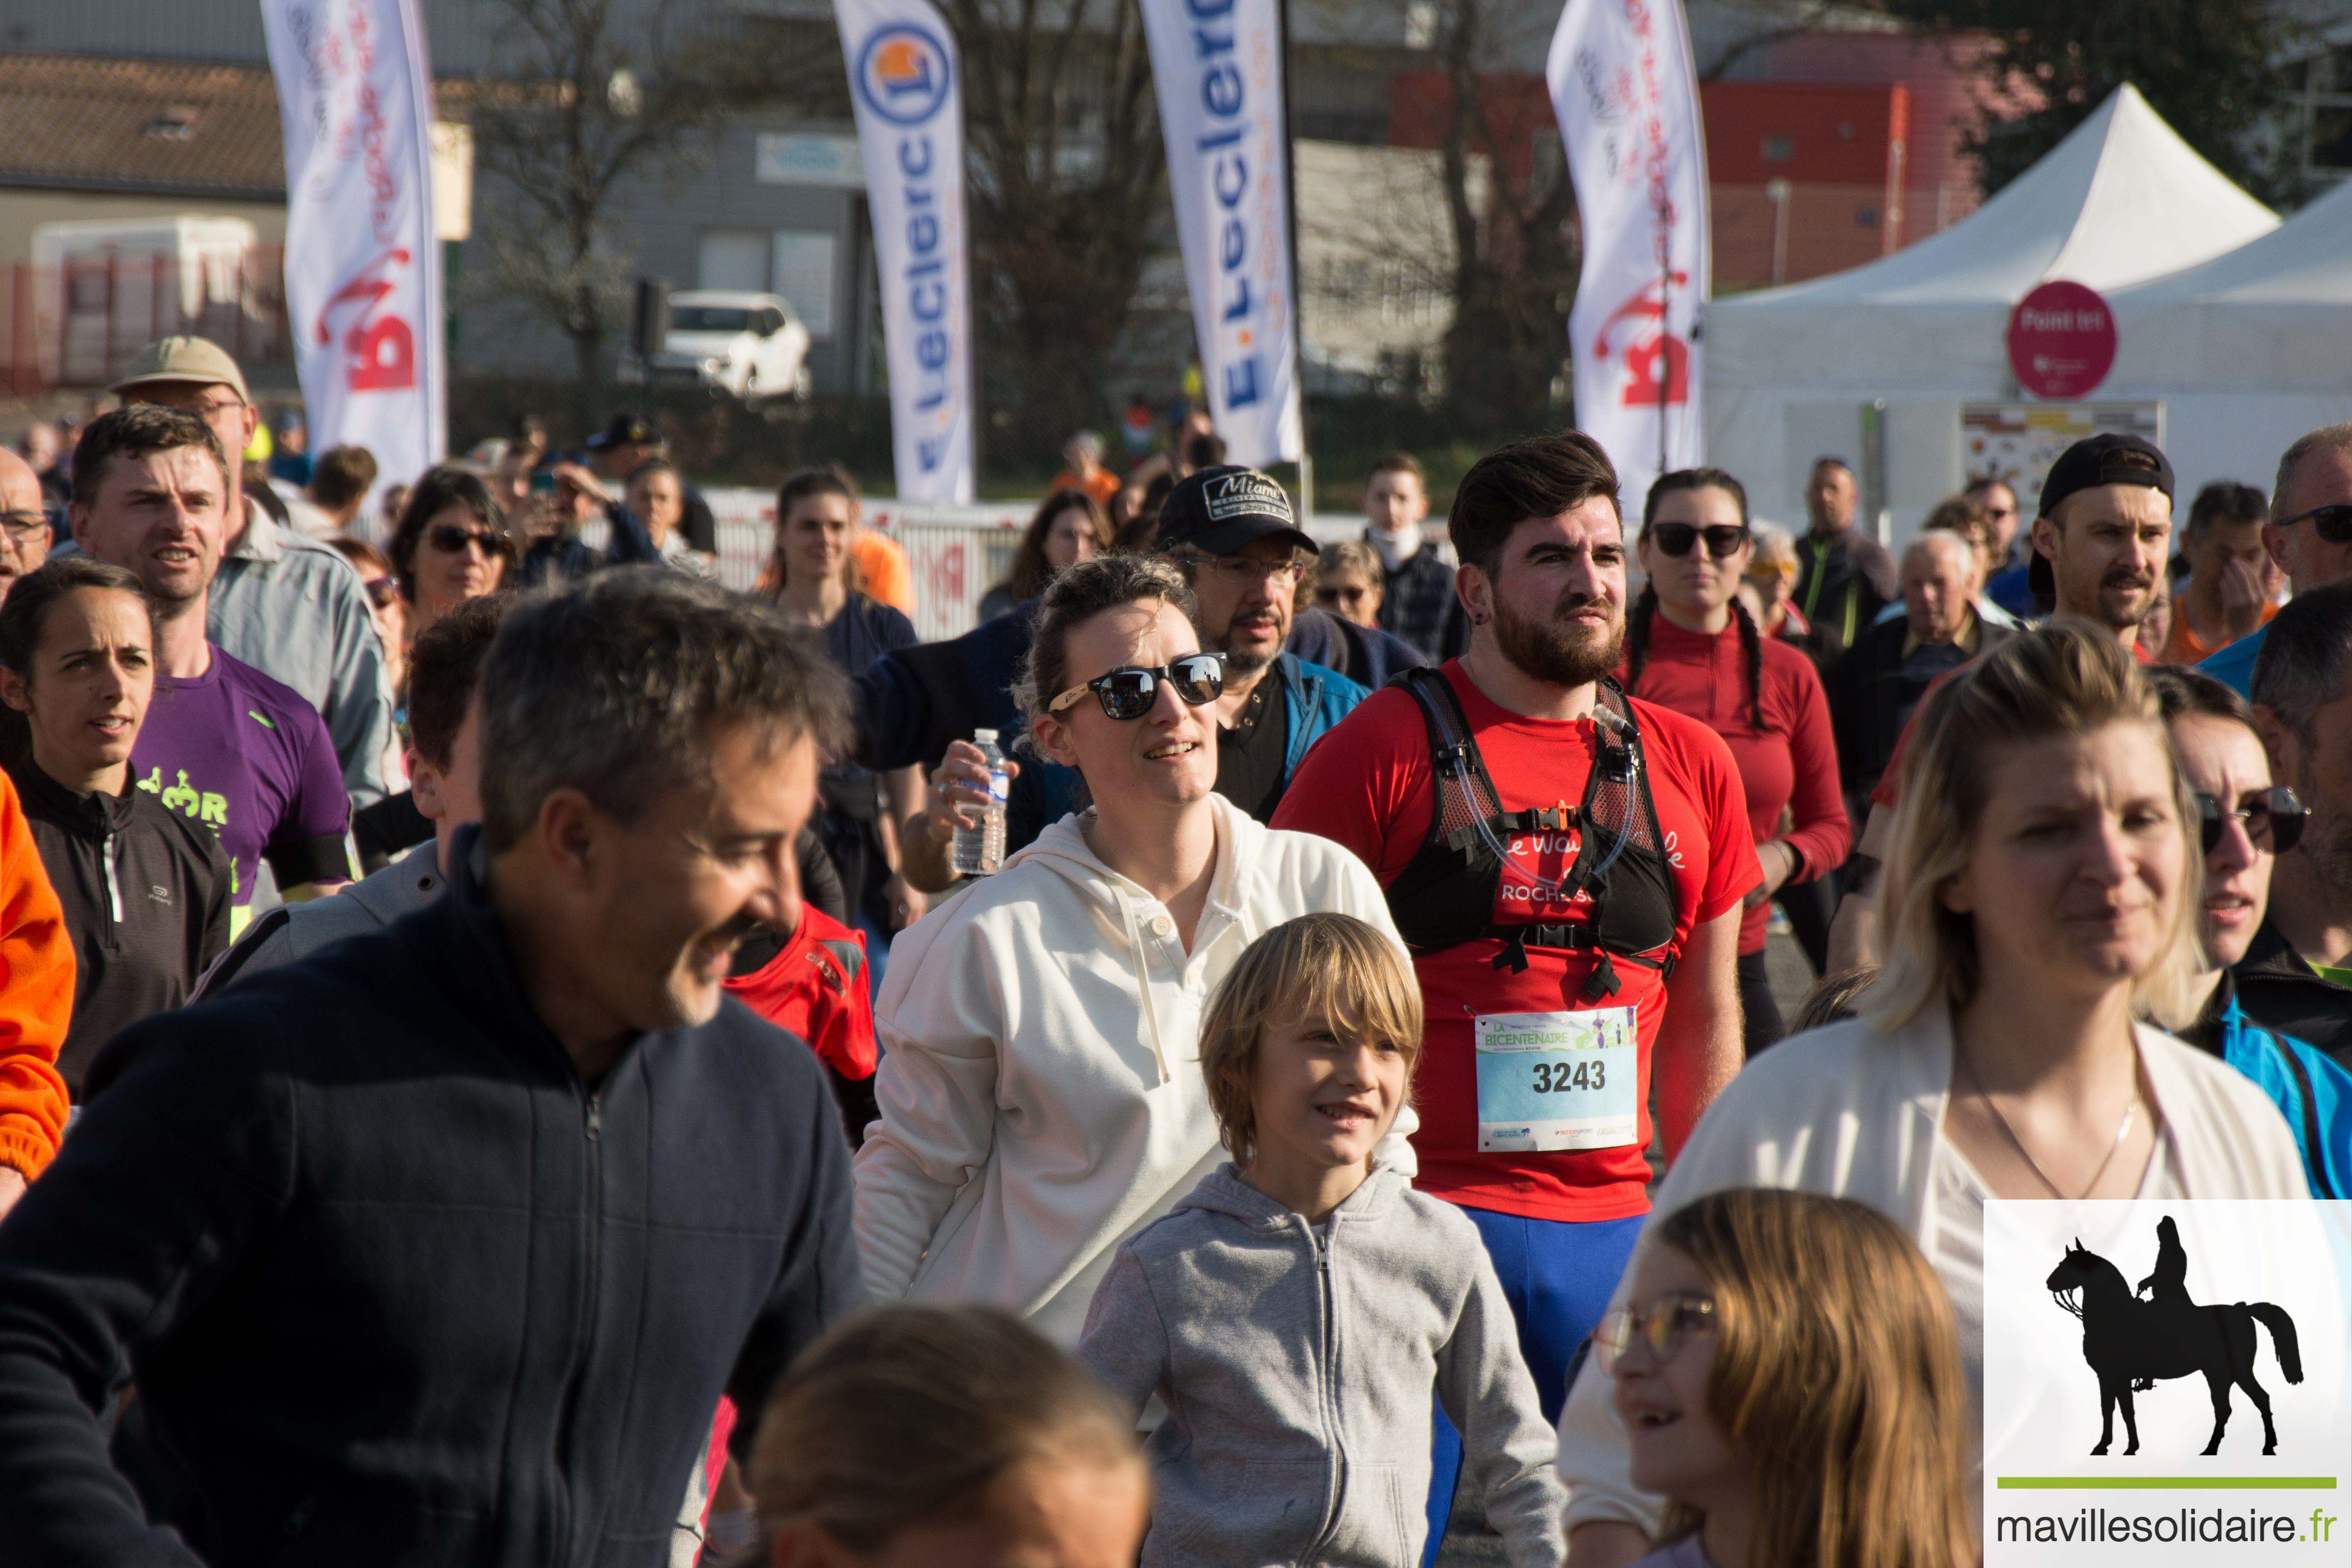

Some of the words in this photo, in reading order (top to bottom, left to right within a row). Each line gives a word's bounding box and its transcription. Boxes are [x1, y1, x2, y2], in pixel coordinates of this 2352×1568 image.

[2021, 308, 2073, 332] Point
[1219, 476, 1281, 500] Miami
[1485, 1032, 1568, 1046] BICENTENAIRE
[1494, 1024, 1505, 1032] LA
[1533, 1060, 1605, 1093] 3243
